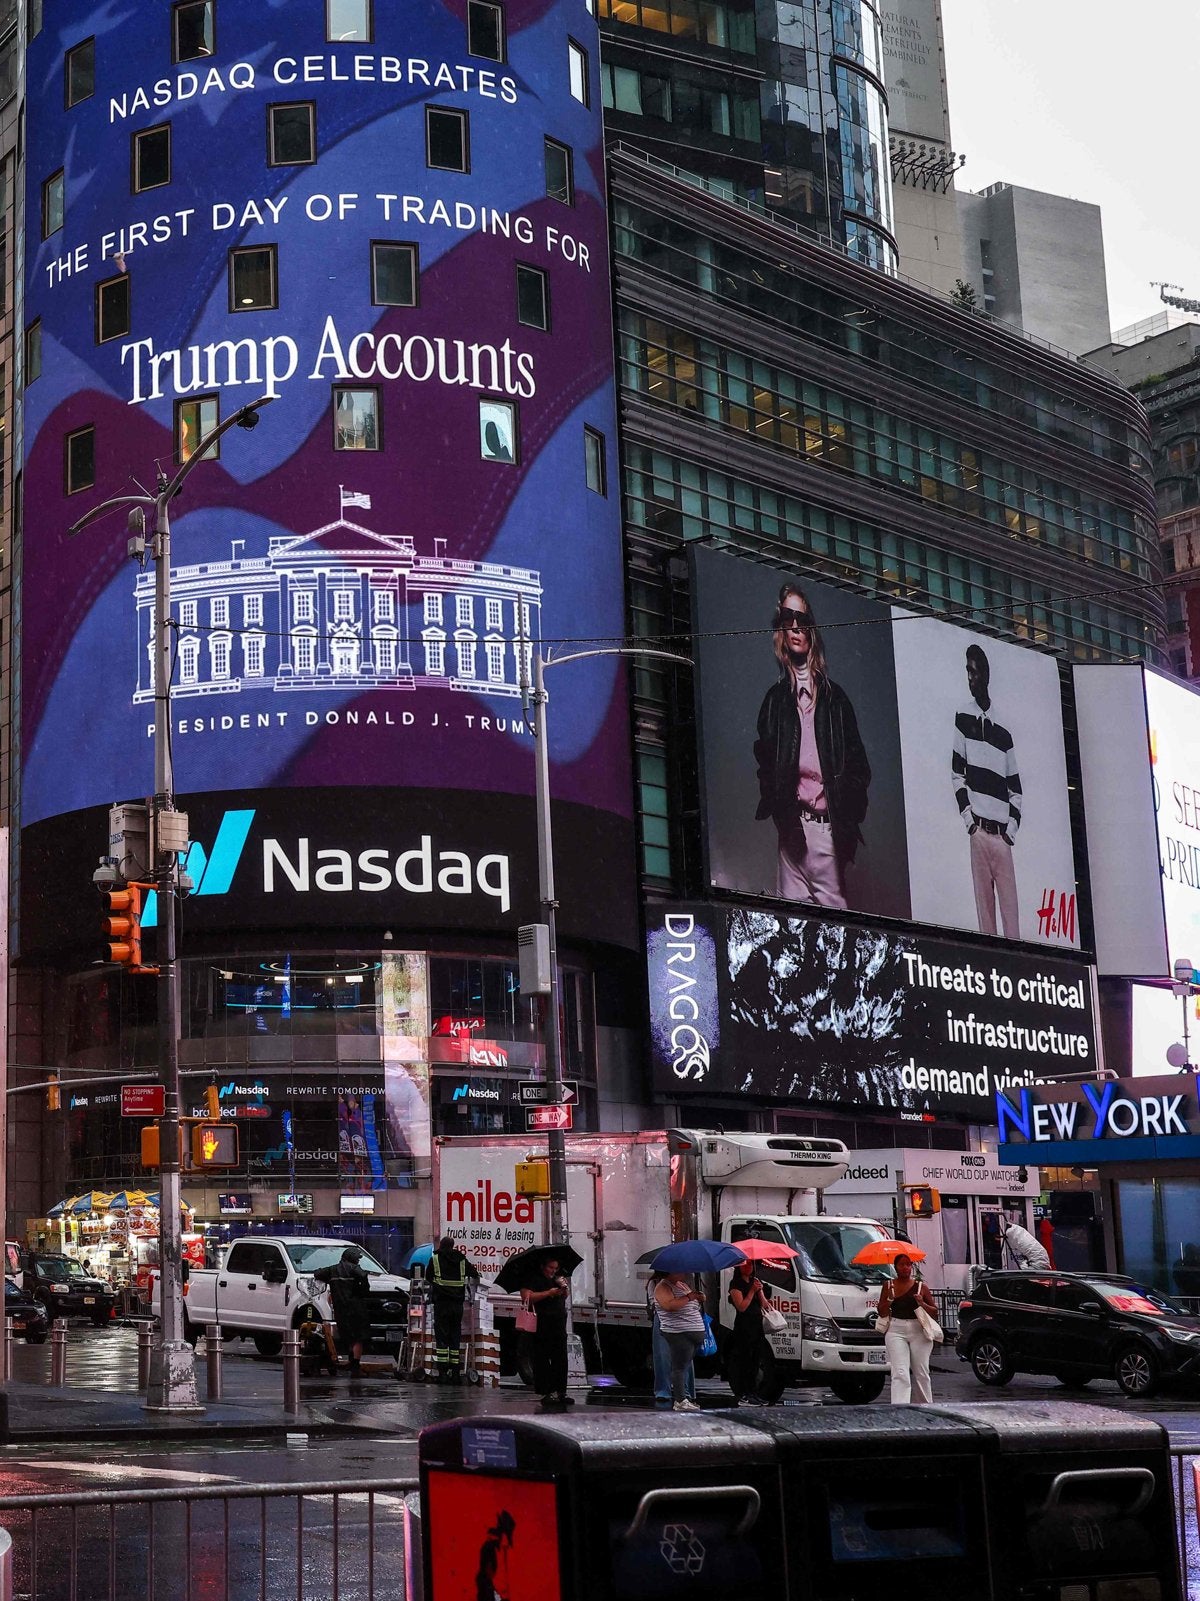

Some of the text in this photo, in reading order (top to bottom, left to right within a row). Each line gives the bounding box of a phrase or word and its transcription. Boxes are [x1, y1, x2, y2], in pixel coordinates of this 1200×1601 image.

[883, 23, 922, 40] LEMENTS
[109, 54, 518, 123] NASDAQ CELEBRATES
[46, 193, 593, 288] THE FIRST DAY OF TRADING FOR
[120, 314, 537, 405] Trump Accounts
[146, 711, 289, 738] PESIDENT
[306, 710, 415, 726] DONALD
[430, 712, 450, 727] J.
[262, 834, 511, 913] Nasdaq
[1037, 888, 1075, 944] H&M
[902, 951, 1086, 1010] Threats to critical
[946, 1009, 1089, 1058] infrastructure
[901, 1057, 990, 1096] demand
[234, 1084, 386, 1096] Nasdaq REWRITE TOMORROW
[468, 1088, 499, 1100] Nasdaq
[526, 1088, 541, 1098] ONE
[124, 1095, 144, 1103] Anytime
[530, 1112, 562, 1123] ONE WAY
[790, 1151, 832, 1160] THERMO KING
[961, 1155, 985, 1166] FOX ONE
[839, 1164, 889, 1180] ndeed
[922, 1166, 1020, 1182] CHIEF WORLD CUP WATCHE
[1008, 1184, 1025, 1192] indeed
[446, 1179, 535, 1223] milea
[447, 1227, 535, 1244] truck sales & leasing
